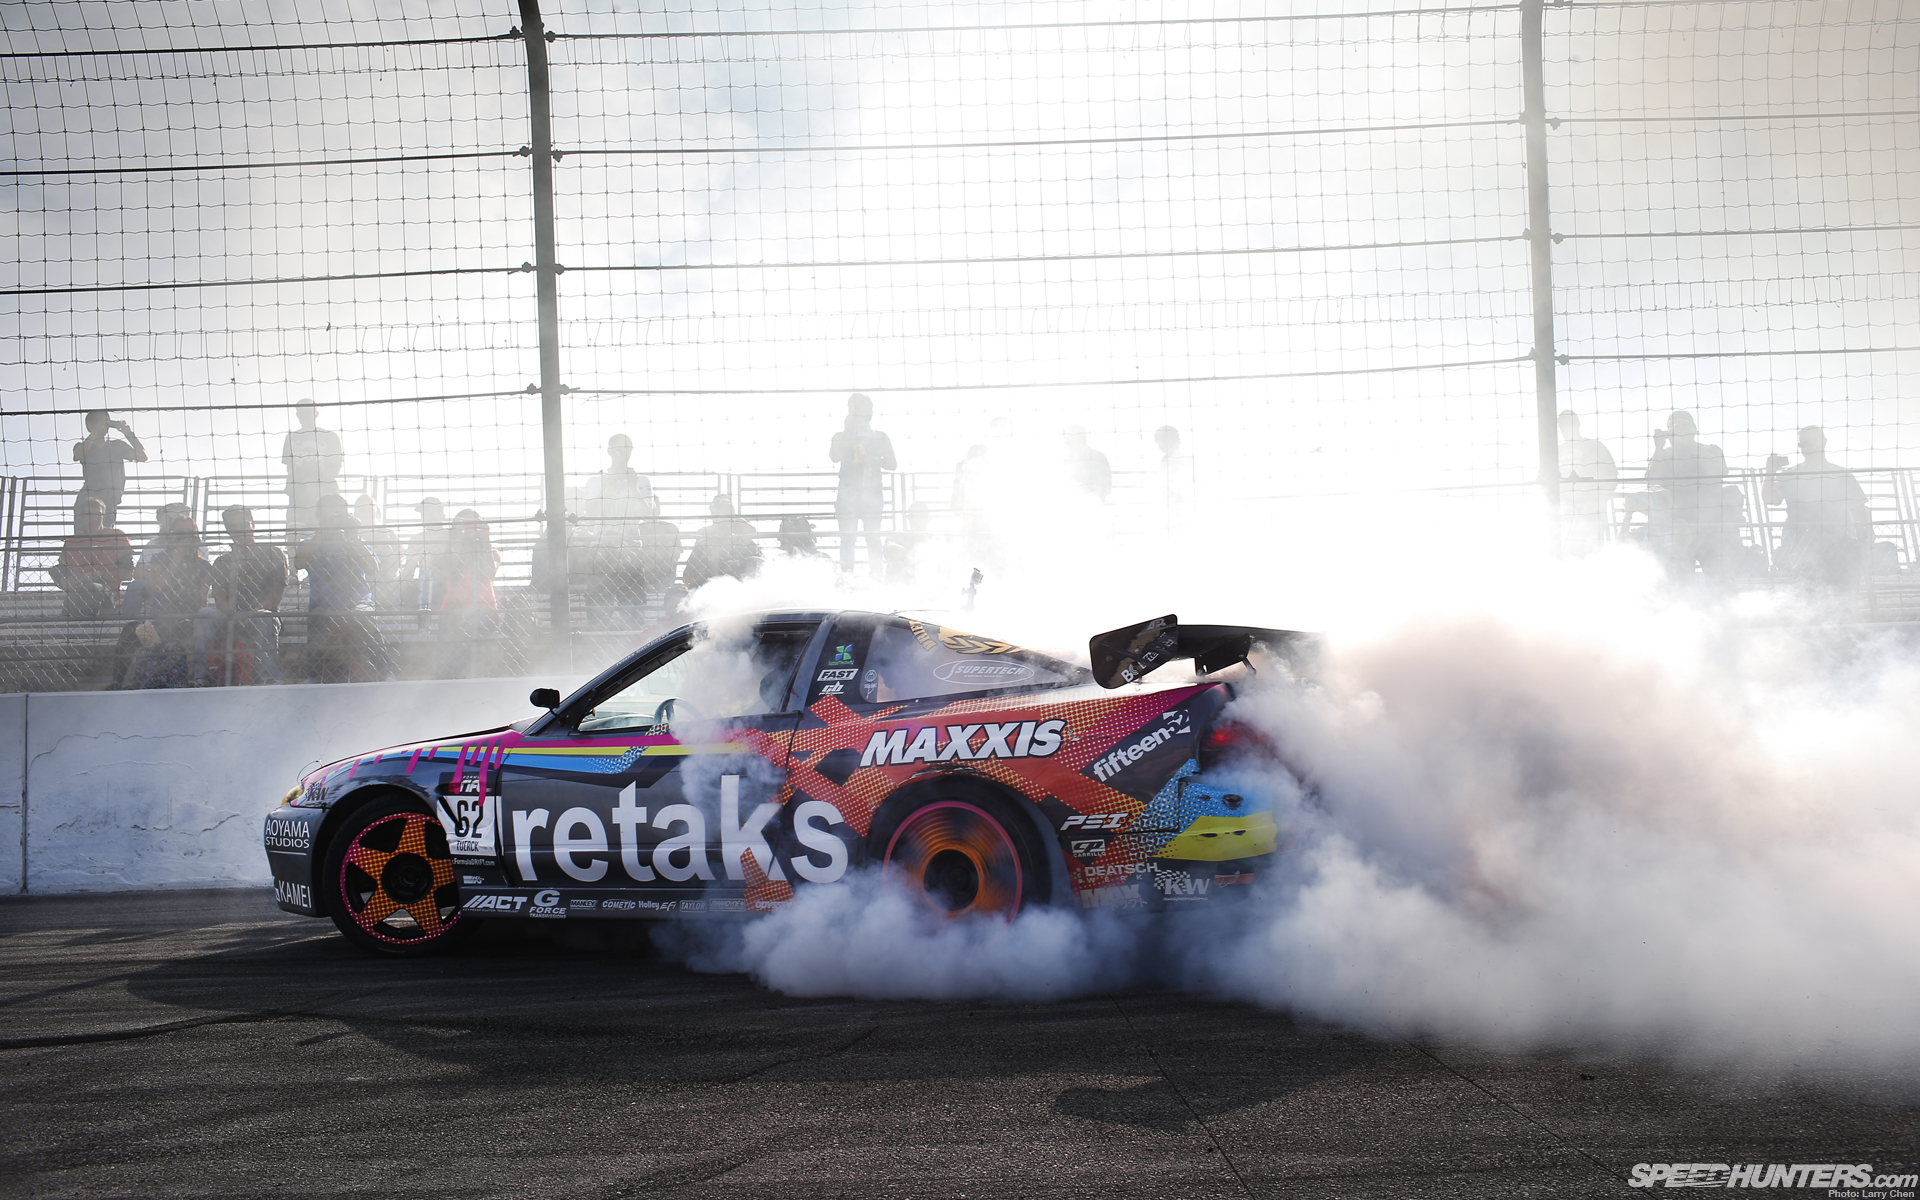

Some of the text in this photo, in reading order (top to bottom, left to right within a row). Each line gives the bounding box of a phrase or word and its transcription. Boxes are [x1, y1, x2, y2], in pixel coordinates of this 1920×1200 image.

[821, 670, 854, 679] FAST
[955, 665, 1025, 675] SUPERTECH
[858, 719, 1067, 768] MAXXIS
[454, 799, 484, 838] 62
[265, 819, 310, 838] AOYAMA
[512, 774, 848, 883] retaks
[265, 836, 310, 849] STUDIOS
[456, 840, 479, 851] TUERCK
[1084, 862, 1158, 877] DEATSCH
[1164, 878, 1211, 895] KW
[278, 880, 312, 909] KAMEI
[533, 889, 561, 907] G
[529, 906, 567, 914] FORCE
[602, 899, 636, 909] COMETIC
[638, 900, 660, 910] Holley
[681, 902, 706, 910] TAYLOR
